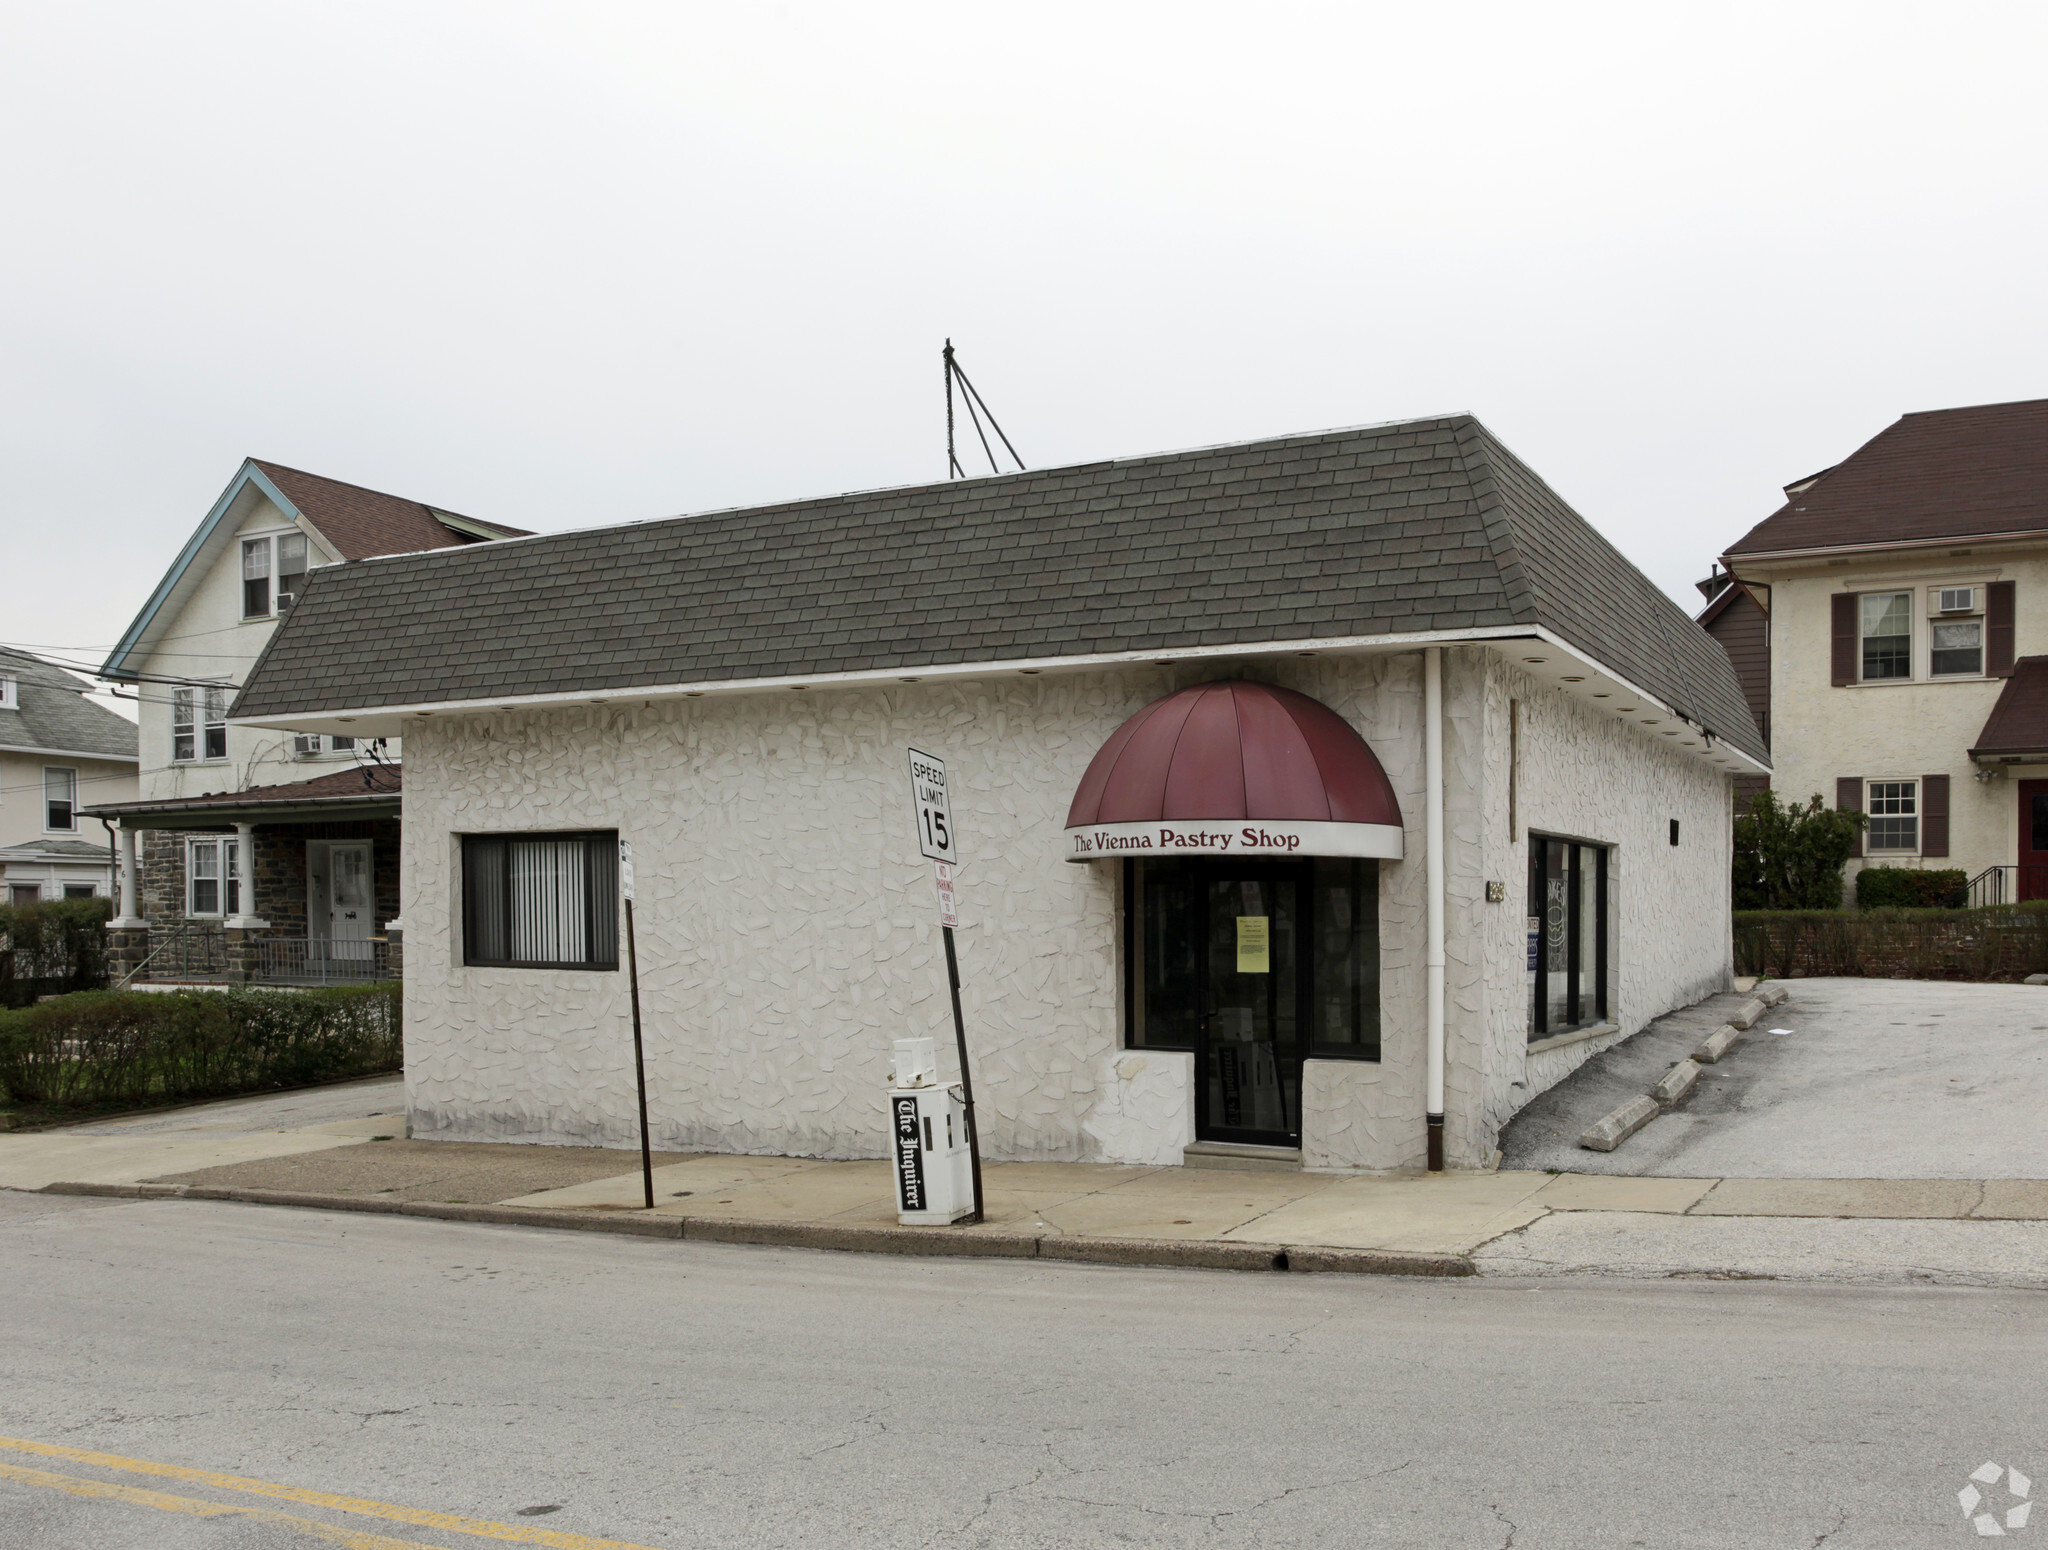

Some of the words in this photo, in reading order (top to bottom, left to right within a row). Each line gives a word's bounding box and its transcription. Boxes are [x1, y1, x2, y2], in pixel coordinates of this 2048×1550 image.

[913, 762, 945, 787] SPEED
[920, 785, 944, 807] LIMIT
[923, 807, 949, 850] 15
[1074, 834, 1092, 852] The
[1095, 832, 1153, 850] Vienna
[1159, 829, 1233, 850] Pastry
[1240, 828, 1300, 851] Shop
[898, 1100, 918, 1133] The
[900, 1136, 921, 1208] Inquirer
